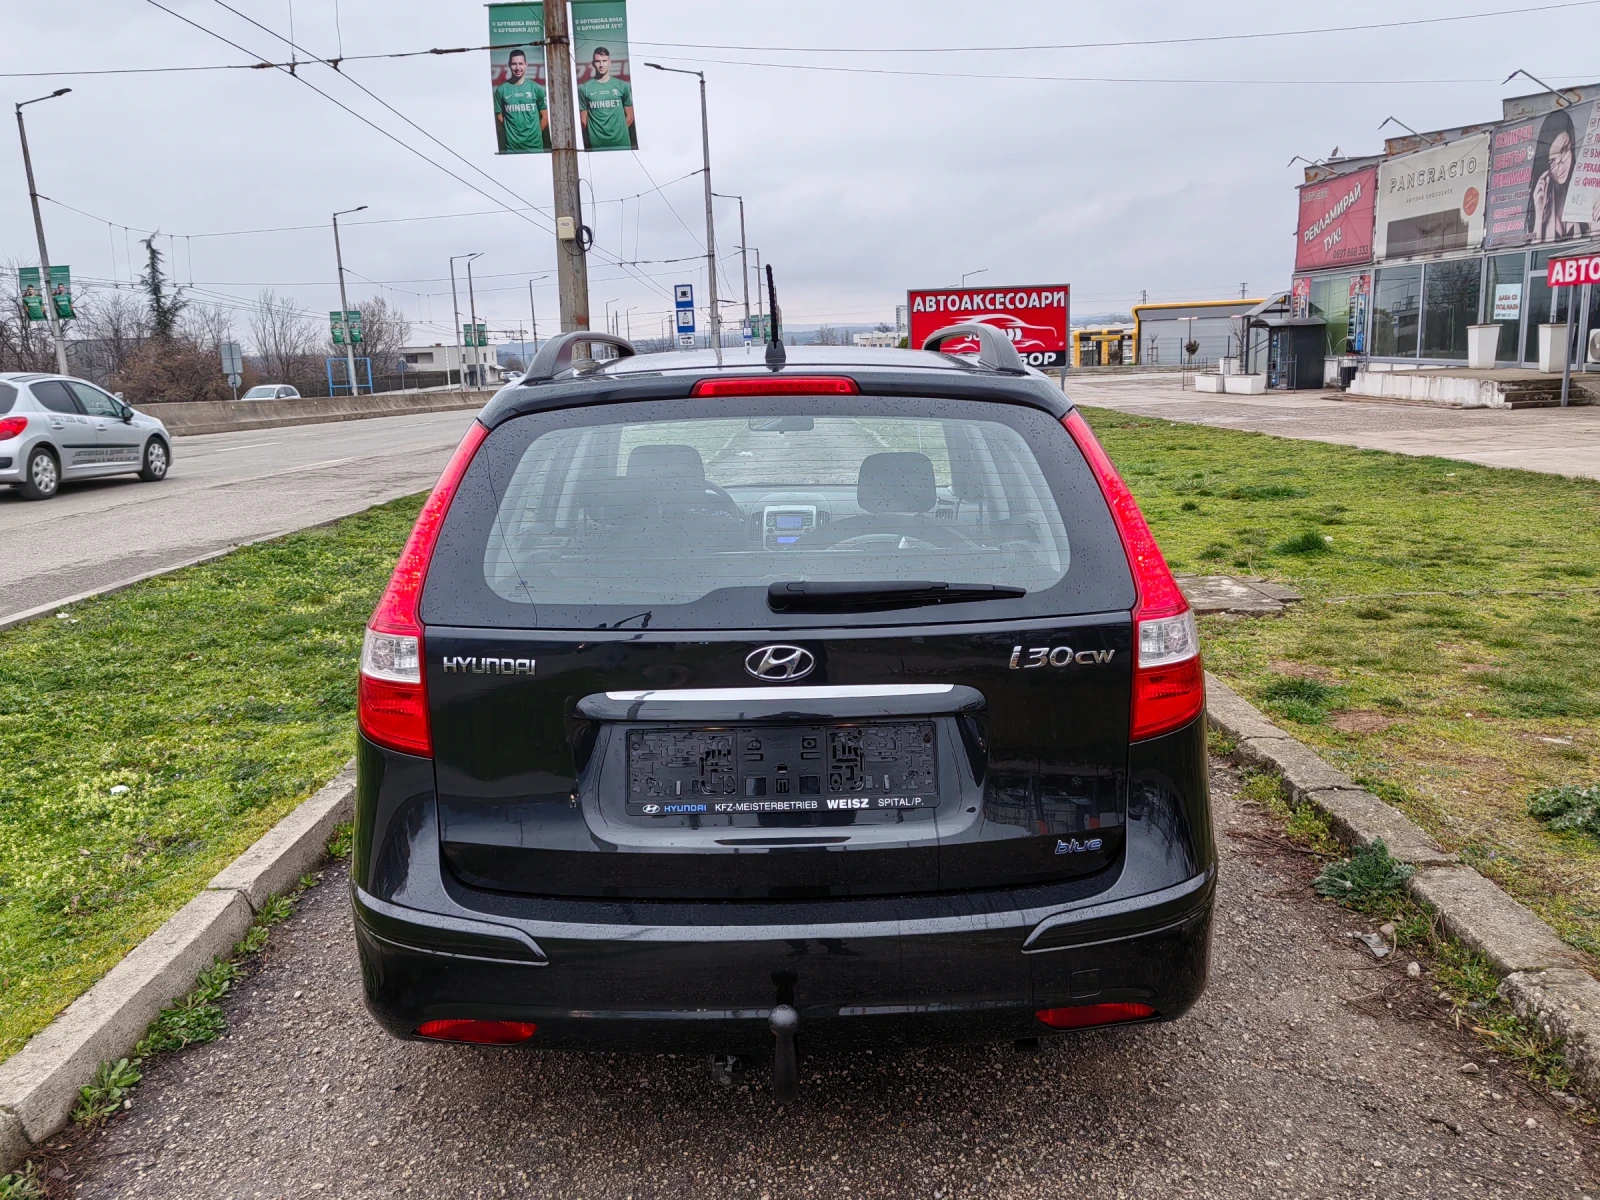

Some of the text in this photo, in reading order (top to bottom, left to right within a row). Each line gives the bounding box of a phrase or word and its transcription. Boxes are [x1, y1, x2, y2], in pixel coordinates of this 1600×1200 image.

[505, 103, 536, 112] WINBET
[589, 99, 621, 109] WINBET
[1495, 125, 1534, 149] КОПИРЕН
[1493, 148, 1527, 171] ЦЕНТЪР
[1389, 156, 1477, 193] PANCRACIO
[1491, 165, 1532, 190] РЕКЛАМА
[1425, 188, 1454, 200] CHOCOLATE
[1304, 180, 1362, 245] РЕКЛАМИРАЙ
[1323, 226, 1343, 252] ТУК!
[1358, 244, 1369, 255] 333
[1550, 257, 1600, 283] АВТО
[913, 291, 1065, 313] АВТОАКСЕСОАРИ
[443, 656, 536, 676] HYUNDAI
[715, 801, 818, 812] KFZ-MEISTERBETRIEB
[826, 798, 870, 809] WEISZ
[877, 798, 925, 807] SPITAL/P.
[1055, 839, 1103, 854] blue
